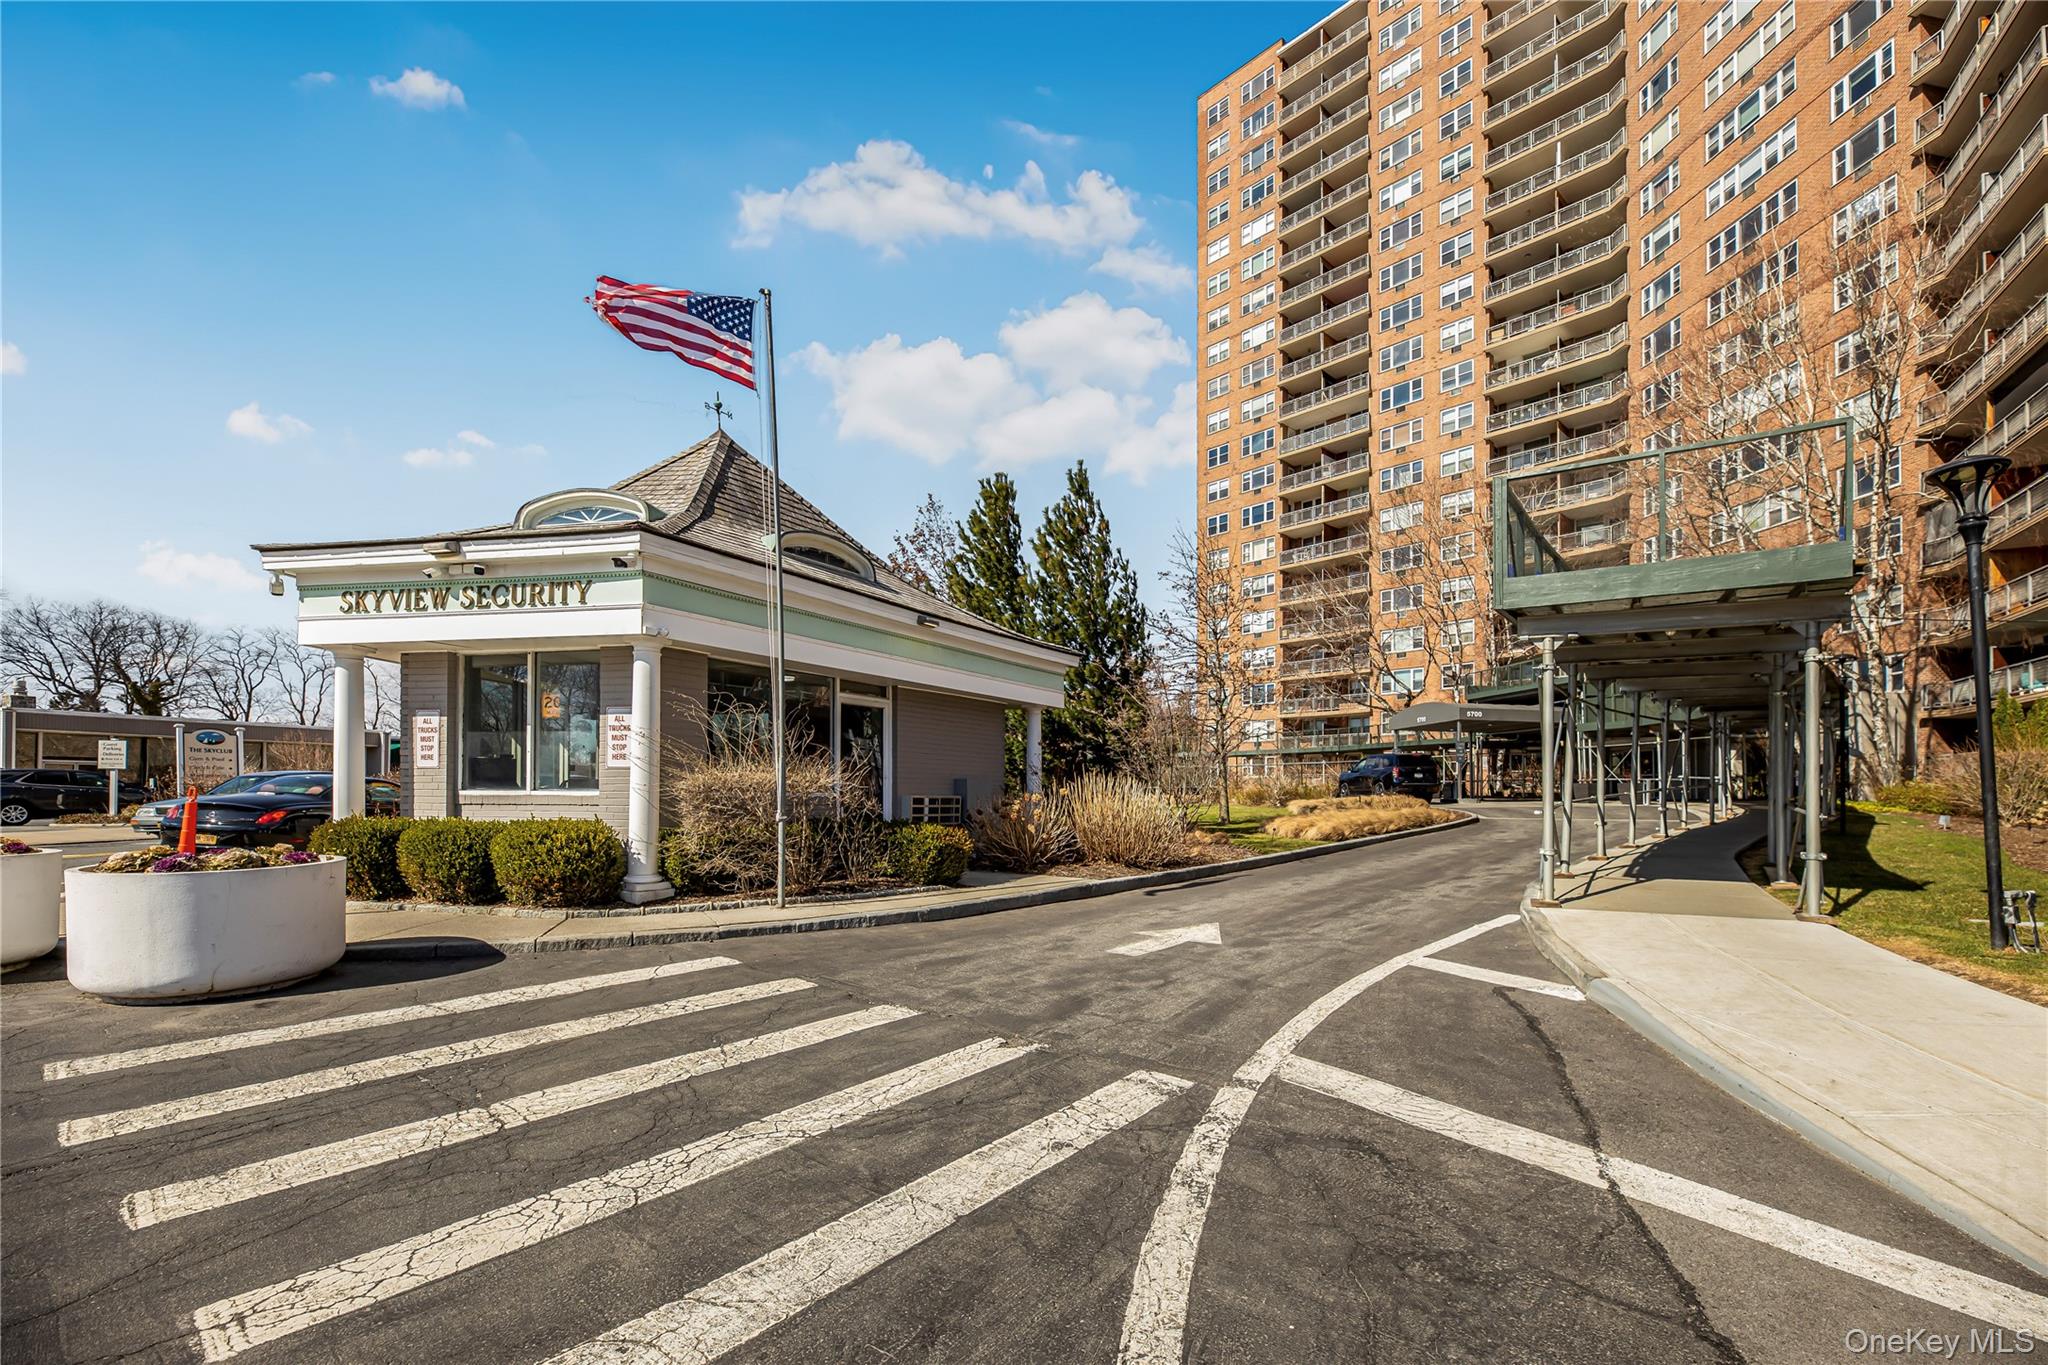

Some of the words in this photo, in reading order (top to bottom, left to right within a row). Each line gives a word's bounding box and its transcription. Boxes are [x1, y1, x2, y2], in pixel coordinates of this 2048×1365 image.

[340, 587, 451, 614] SKYVIEW
[460, 580, 593, 610] SECURITY
[611, 734, 628, 742] MUST
[611, 743, 628, 751] STOP
[611, 753, 628, 761] HERE
